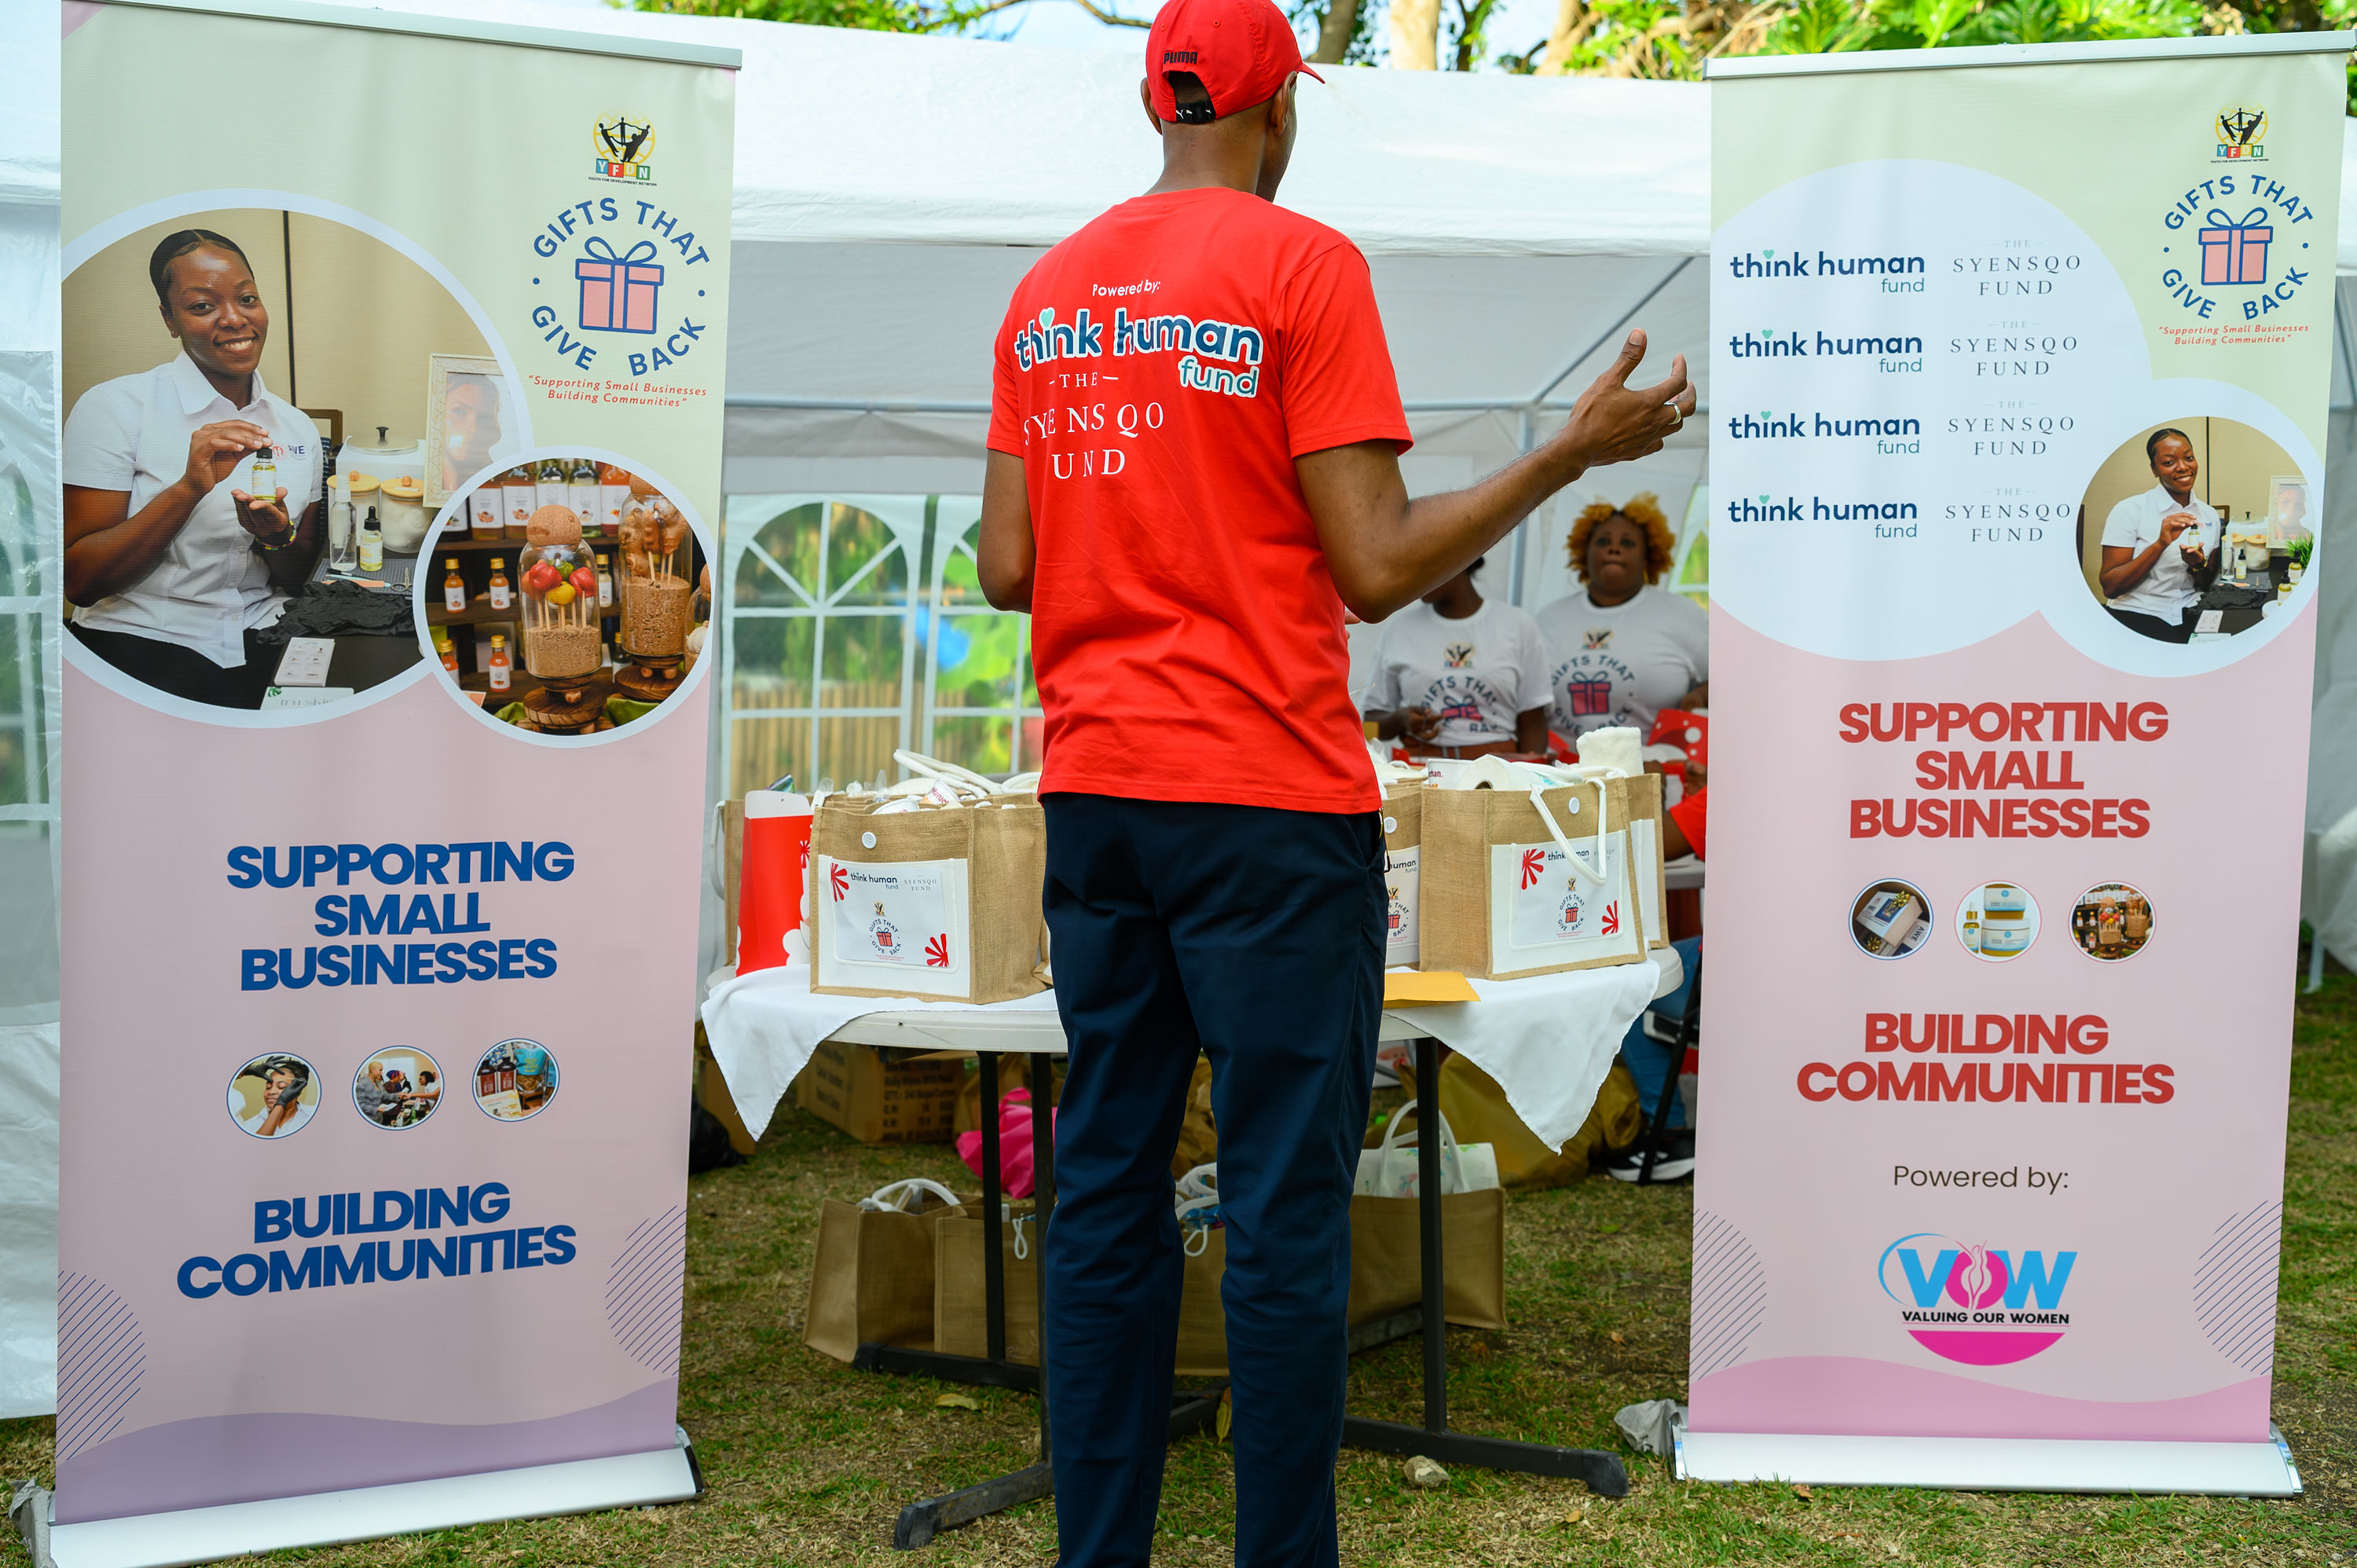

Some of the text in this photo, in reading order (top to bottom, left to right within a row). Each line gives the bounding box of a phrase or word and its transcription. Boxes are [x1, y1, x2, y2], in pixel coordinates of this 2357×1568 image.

[1163, 51, 1197, 64] PUMA
[2218, 145, 2263, 158] YFDN
[597, 159, 648, 179] YFDN
[2165, 174, 2313, 229] GIFTS THAT
[533, 197, 710, 266] GIFTS THAT
[2003, 240, 2030, 248] THE
[1730, 249, 1925, 278] think human
[1953, 255, 2080, 274] SYENSQO
[1092, 279, 1160, 296] Powered by:
[1881, 278, 1925, 293] fund
[1979, 280, 2052, 295] FUND
[2162, 266, 2309, 321] GIVE BACK
[2223, 324, 2250, 333] Small
[533, 306, 706, 376] GIVE BACK
[1014, 307, 1263, 372] think human
[1729, 329, 1923, 357] think human
[1950, 336, 2077, 355] SYENSQO
[2175, 337, 2217, 346] Building
[1879, 358, 1923, 373] fund
[1976, 361, 2049, 376] FUND
[1059, 372, 1098, 388] THE
[1178, 355, 1259, 397] fund
[529, 376, 706, 396] "Supporting Small Businesses
[548, 390, 687, 407] Building Communities"
[1998, 401, 2025, 409] THE
[1024, 402, 1164, 446] SYENSQO
[1728, 410, 1920, 438] think human
[1948, 416, 2073, 434] SYENSQO
[1877, 440, 1920, 456] fund
[1974, 441, 2046, 456] FUND
[1051, 449, 1125, 479] UND
[1728, 494, 1917, 522] think human
[1945, 504, 2070, 522] SYENSQO
[1875, 523, 1917, 538] fund
[1971, 528, 2043, 542] FUND
[1599, 654, 1634, 682] THAT
[1839, 702, 2168, 743] SUPPORTING
[1915, 750, 2084, 790] SMALL
[1849, 798, 2150, 839] BUSINESSES
[226, 841, 574, 888] SUPPORTING
[1548, 851, 1565, 860] think
[851, 873, 897, 883] think human
[1395, 903, 1409, 914] THAT
[1560, 894, 1585, 910] GIFTS THAT
[315, 892, 490, 936] SMALL
[869, 919, 898, 932] GIFTS THAT
[1393, 923, 1408, 936] BACK
[1558, 918, 1584, 931] GIVE BACK
[872, 941, 901, 955] GIVE BACK
[241, 939, 557, 991] BUSINESSES
[1865, 1013, 2108, 1055] BUILDING
[1797, 1061, 2175, 1105] COMMUNITIES
[1893, 1166, 2069, 1195] Powered by:
[254, 1182, 510, 1244] BUILDING
[177, 1225, 577, 1299] COMMUNITIES
[1897, 1247, 2078, 1310] VOW
[1902, 1311, 2069, 1324] VALUING OUR WOMEN
